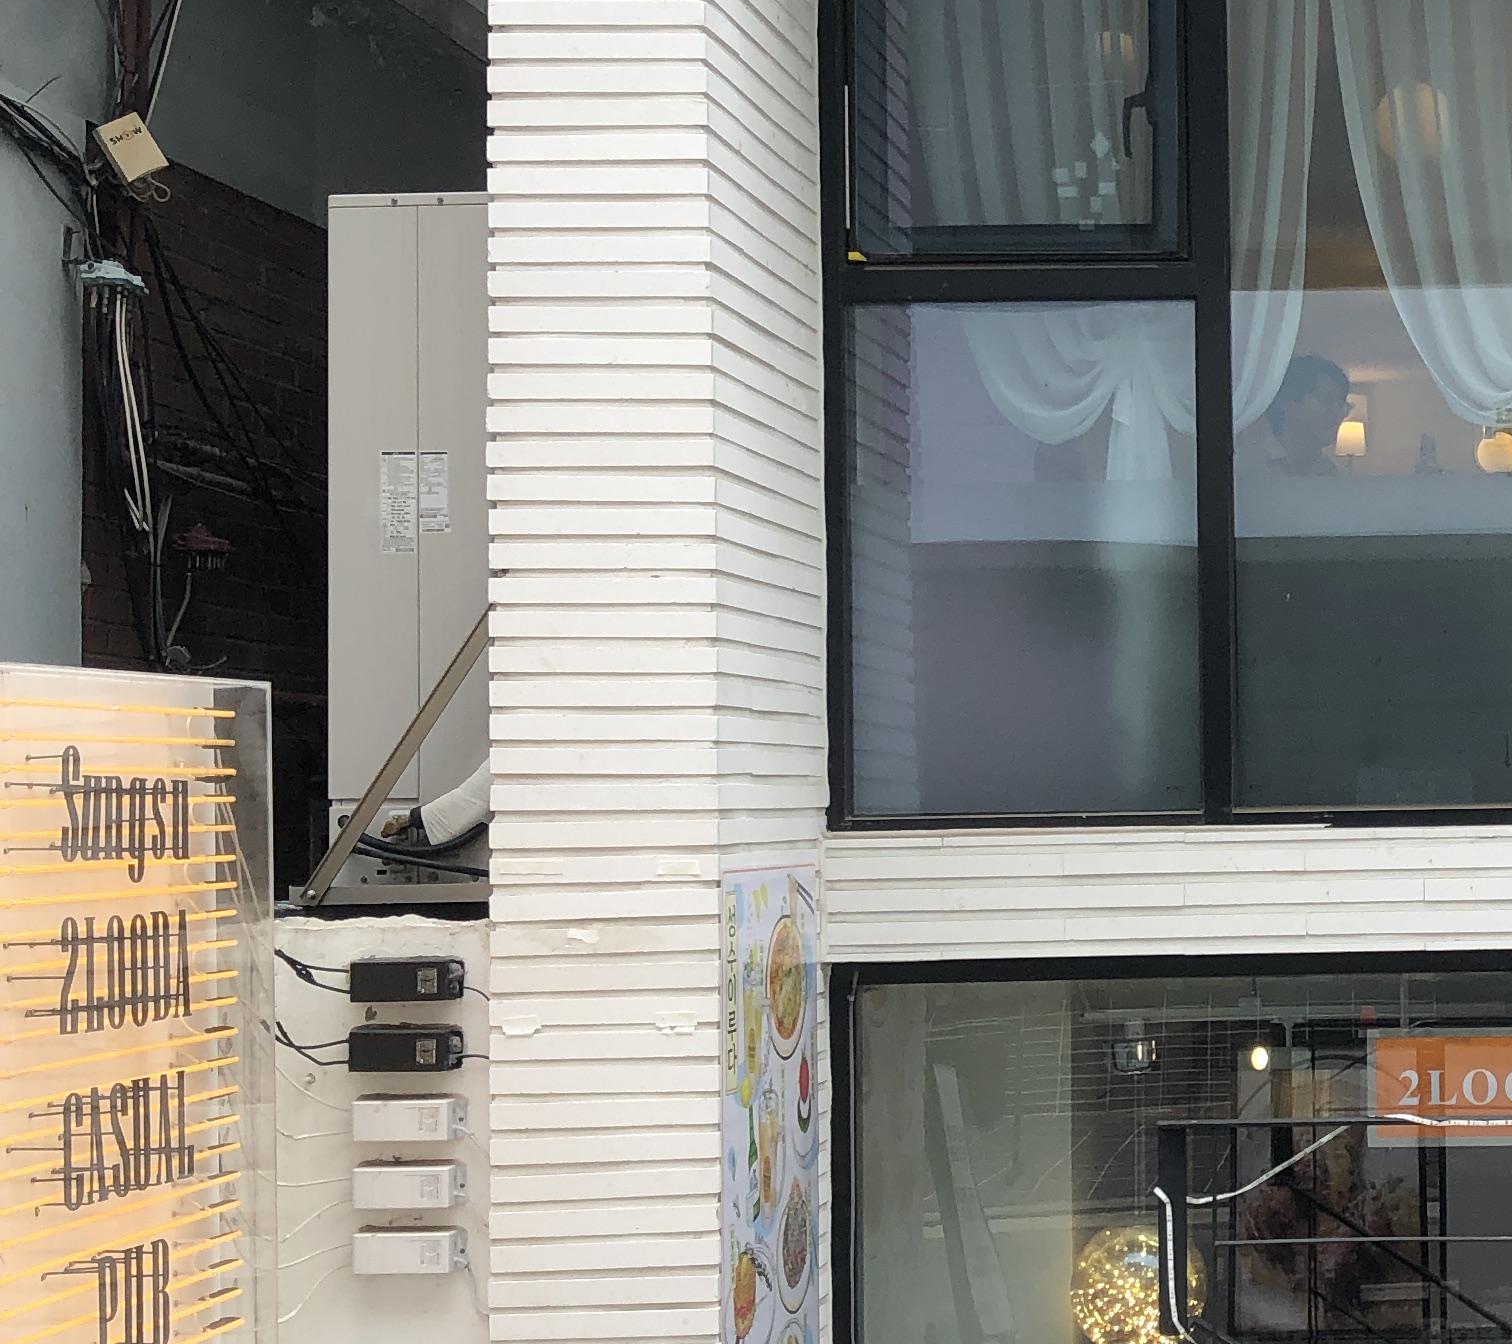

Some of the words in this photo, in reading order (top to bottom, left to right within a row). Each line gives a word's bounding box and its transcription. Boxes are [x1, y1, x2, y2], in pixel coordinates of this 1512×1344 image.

[60, 908, 192, 1036] 2LOODA
[725, 905, 738, 1075] 성수이루다
[62, 1069, 195, 1211] CASUAL
